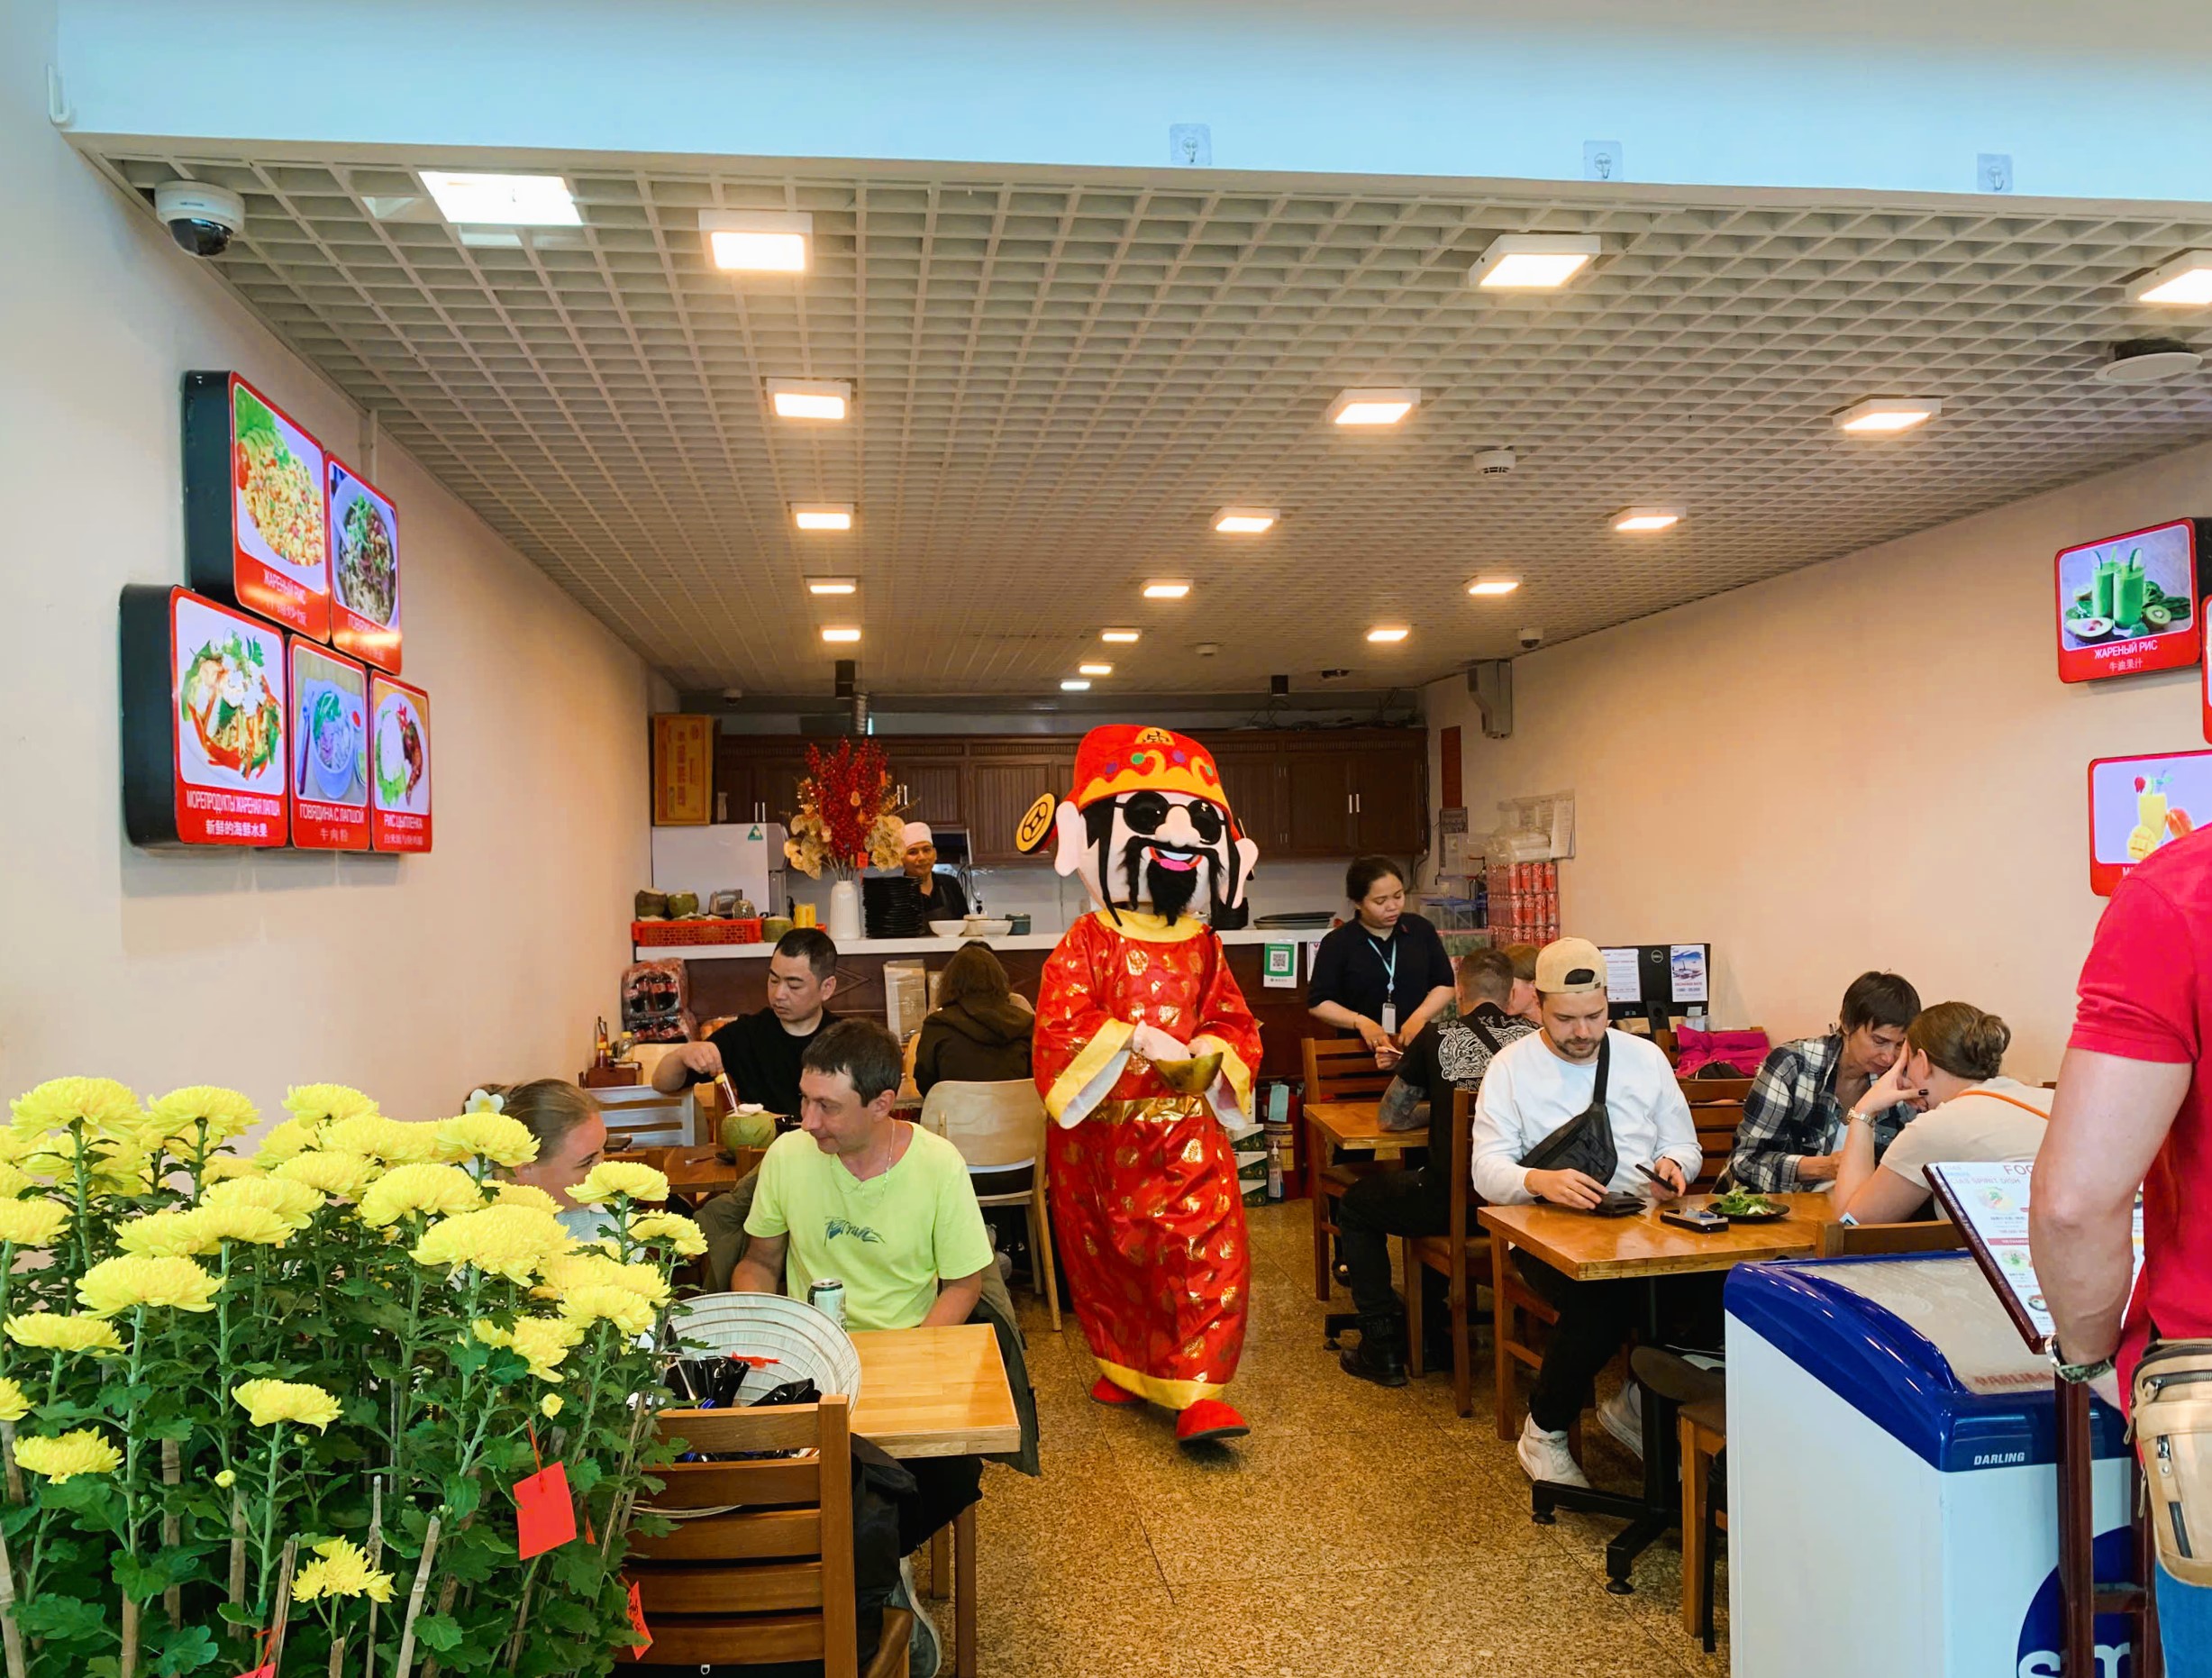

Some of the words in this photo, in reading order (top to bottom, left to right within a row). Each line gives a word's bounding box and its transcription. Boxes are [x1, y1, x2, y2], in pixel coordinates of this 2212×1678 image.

[2094, 642, 2138, 659] ЖАРЕНЫЙ
[2139, 640, 2158, 652] РИС
[299, 804, 333, 822] ГОВЯДИНА
[340, 808, 364, 824] ЛАПШОЙ
[1973, 1452, 2025, 1465] DARLING
